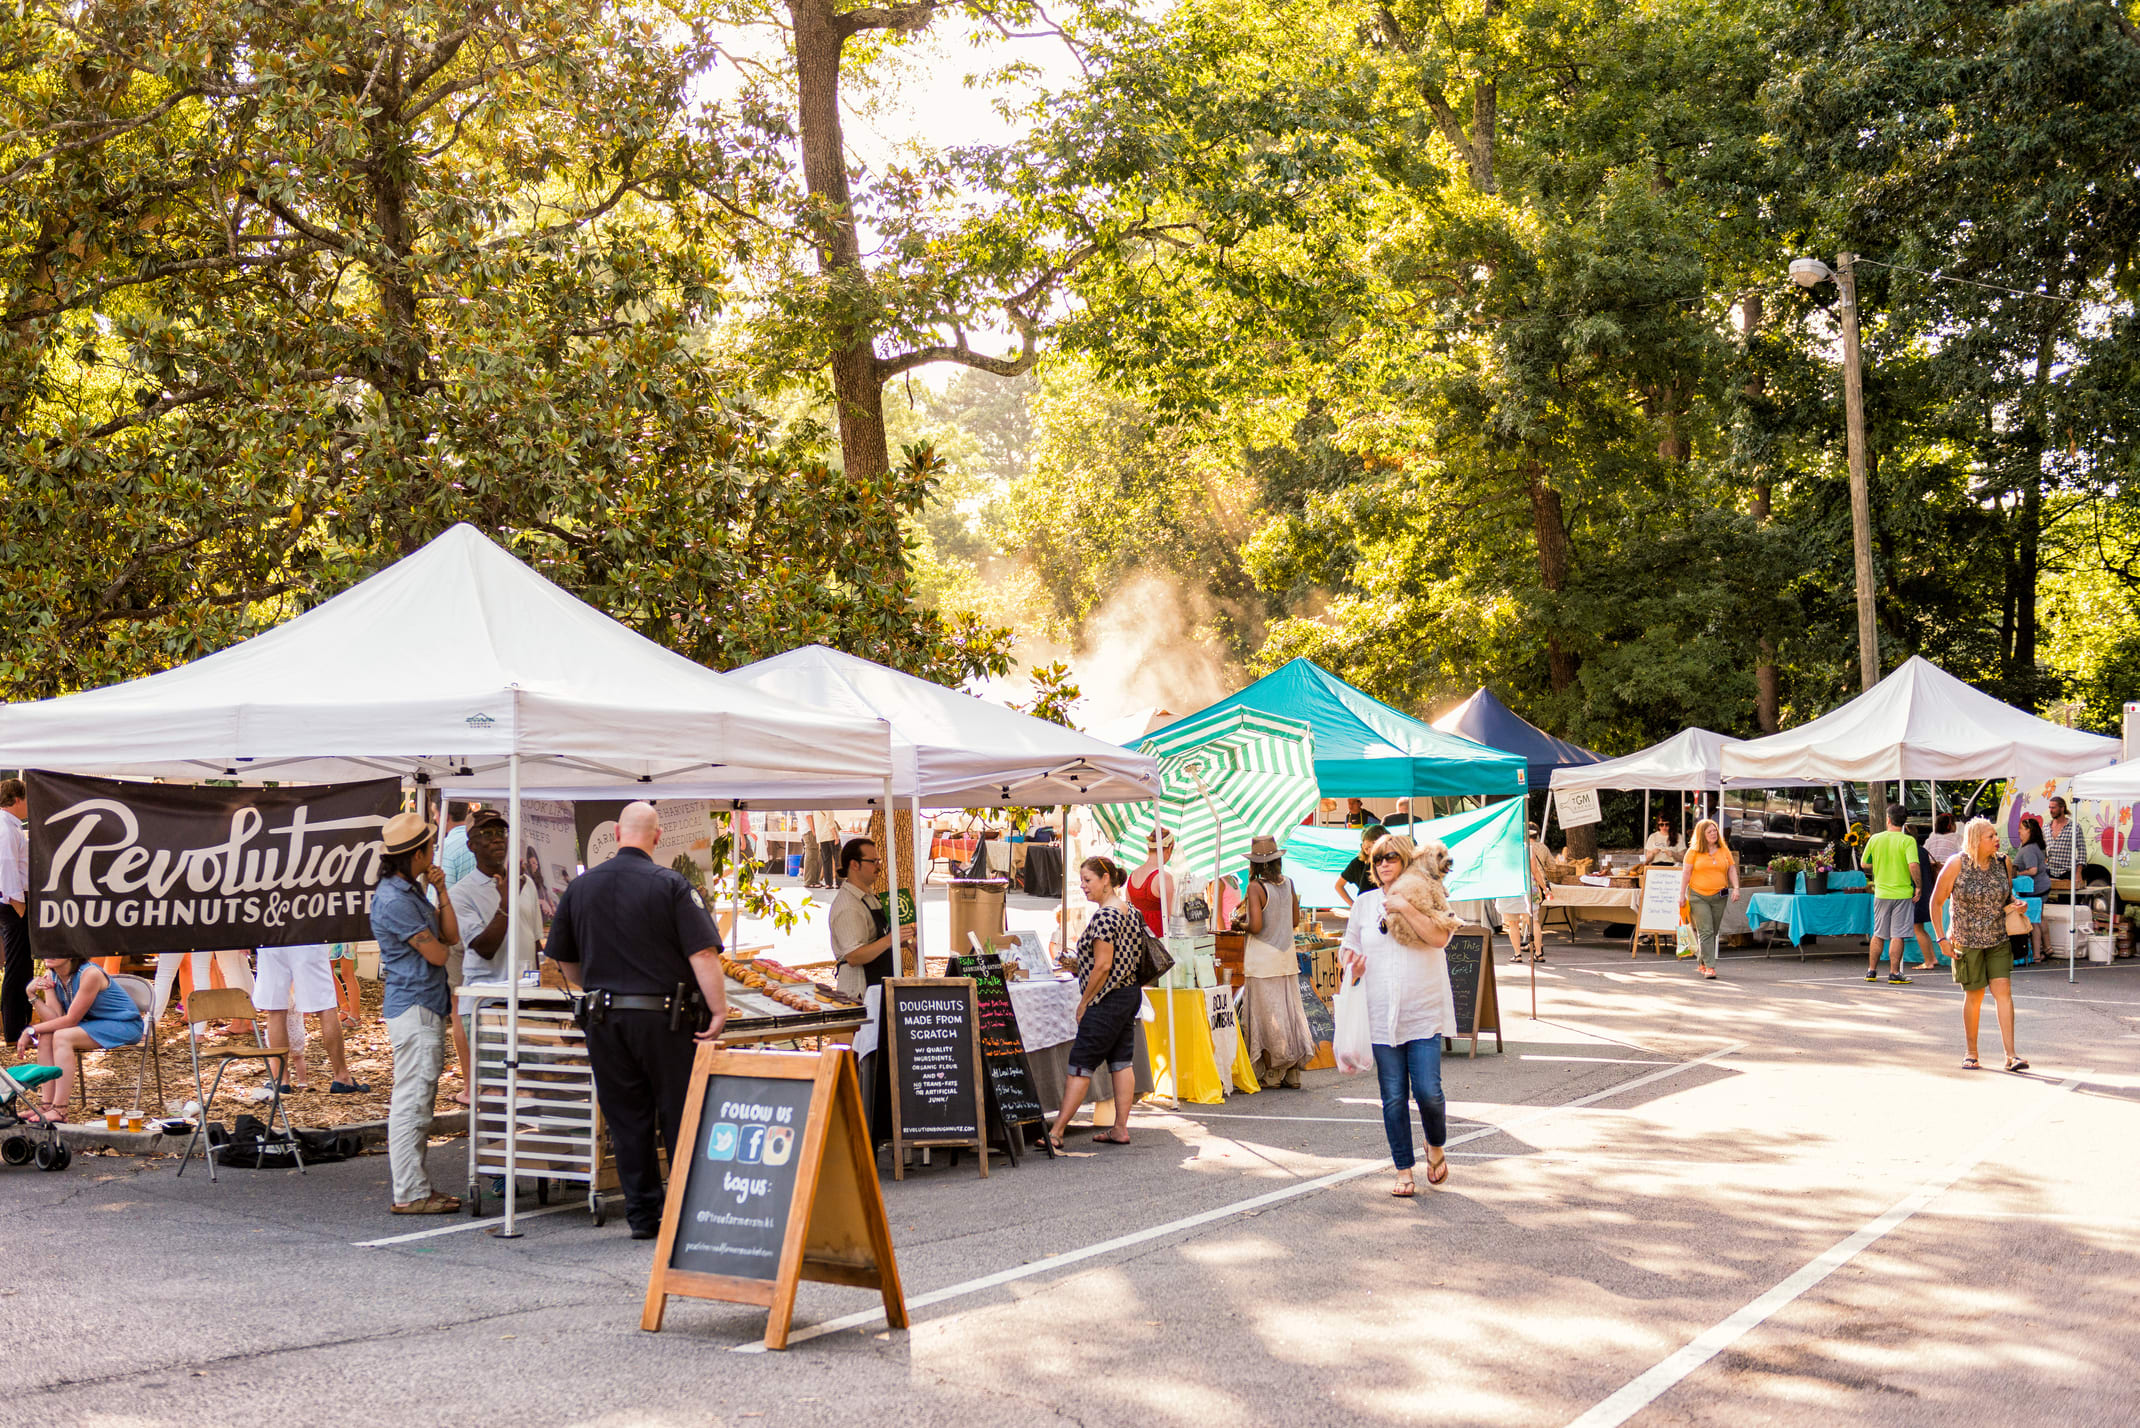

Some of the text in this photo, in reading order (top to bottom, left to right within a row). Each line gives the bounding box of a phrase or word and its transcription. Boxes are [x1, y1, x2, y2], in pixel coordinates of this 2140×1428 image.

[40, 798, 393, 898] Revolution
[899, 1000, 964, 1012] DOUGHNUTS
[904, 1015, 963, 1025] MADE FROM
[910, 1029, 958, 1040] SCRATCH
[913, 1082, 922, 1090] NO
[925, 1087, 957, 1095] ARTIFICIAL
